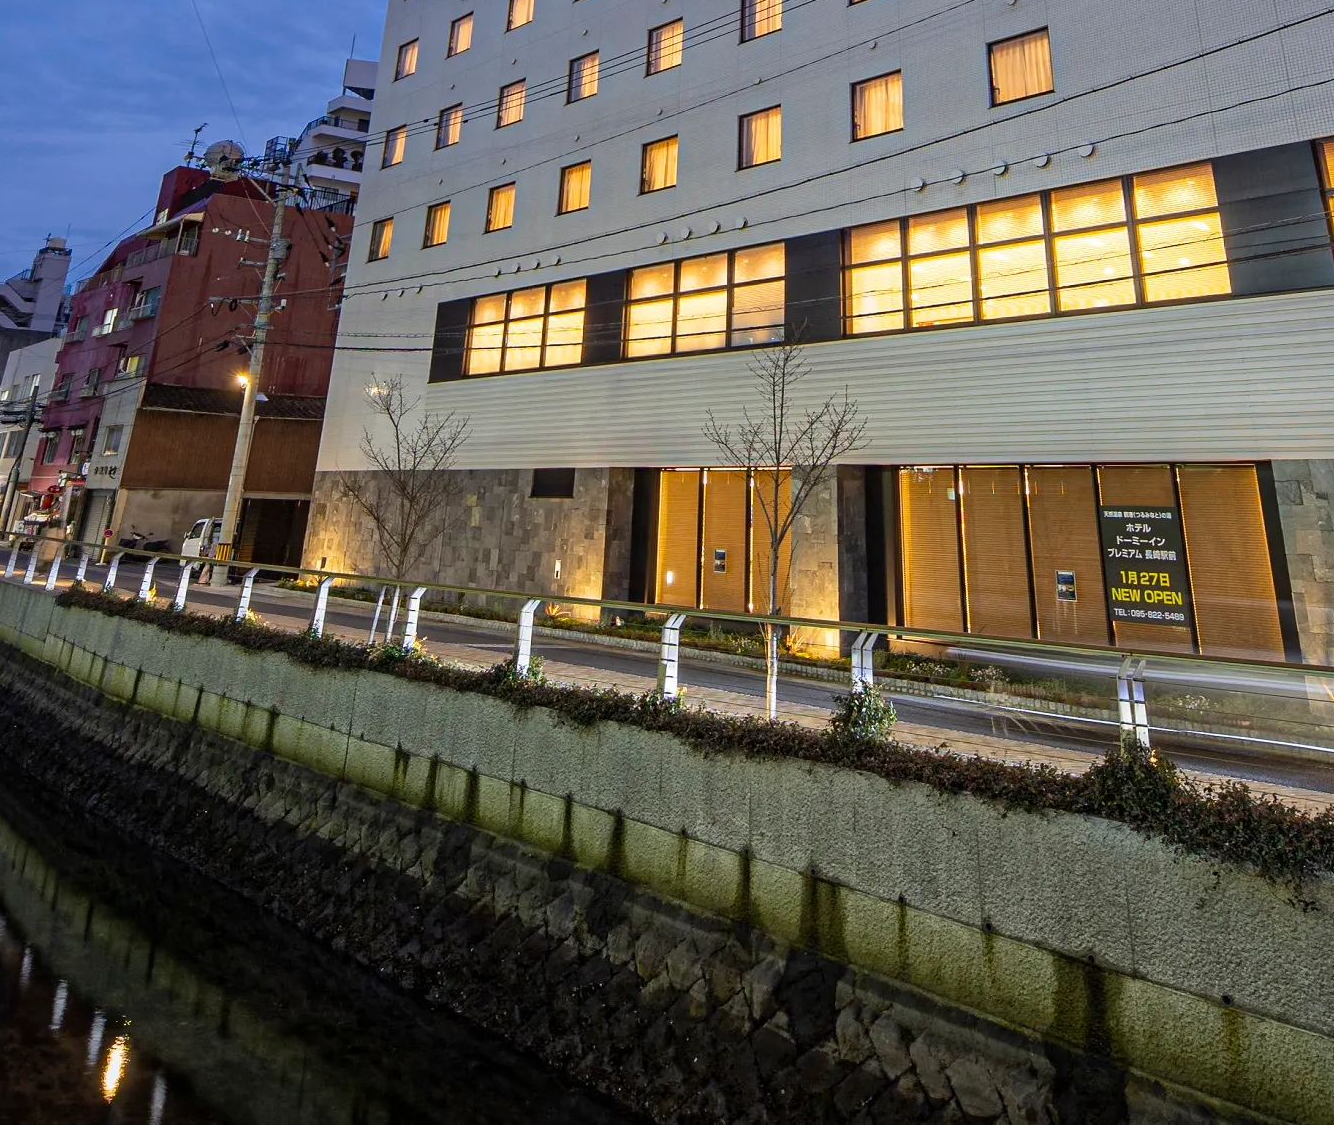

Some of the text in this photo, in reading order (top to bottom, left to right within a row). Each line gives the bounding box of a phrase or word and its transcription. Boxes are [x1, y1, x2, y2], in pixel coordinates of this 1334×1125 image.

[1125, 523, 1151, 532] ホテル
[1116, 535, 1166, 546] ドーミーイン
[1107, 548, 1177, 561] プレミアム 長崎駅前
[1120, 571, 1170, 586] 1月27日
[1111, 587, 1183, 605] NEW OPEN
